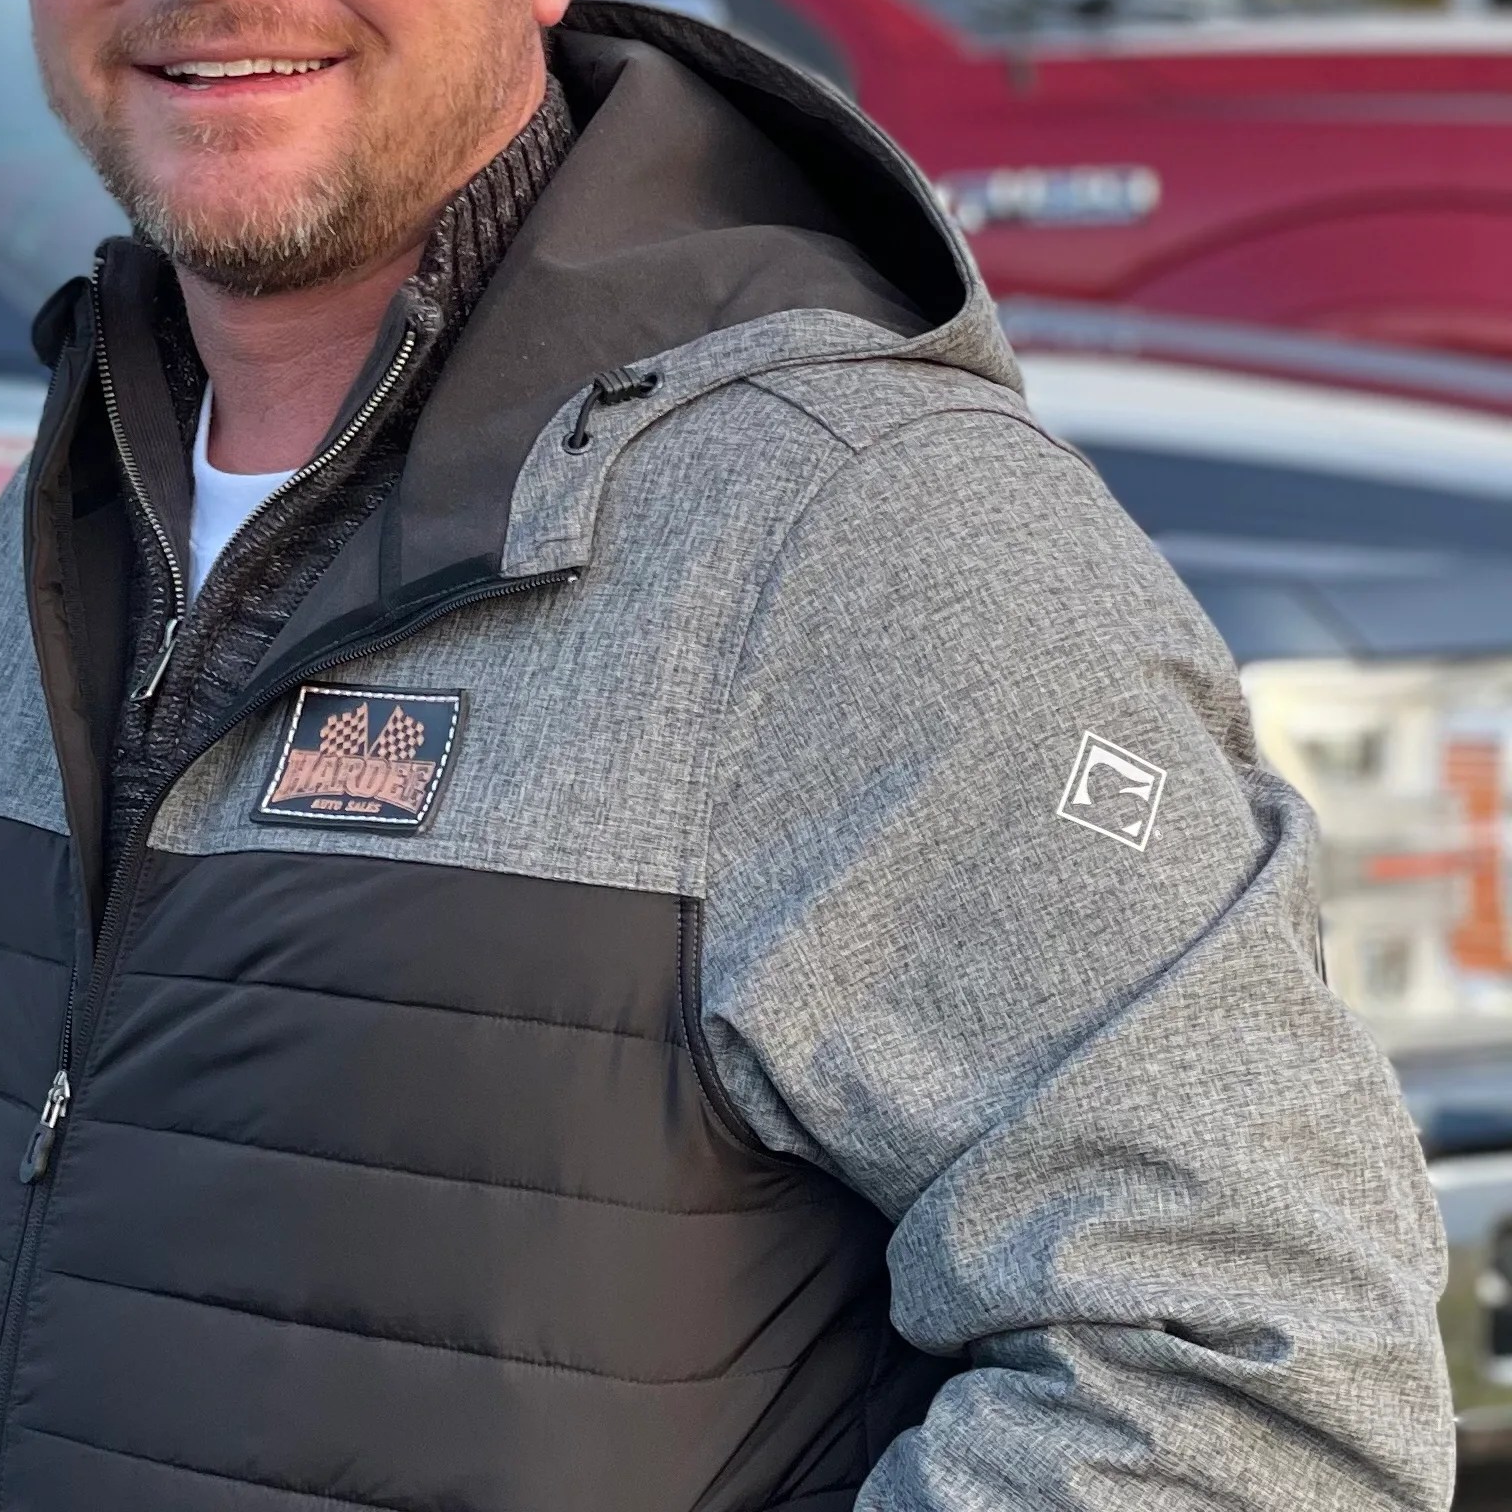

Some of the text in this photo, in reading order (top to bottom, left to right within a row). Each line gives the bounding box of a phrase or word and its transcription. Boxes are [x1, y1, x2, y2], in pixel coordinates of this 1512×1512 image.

[271, 748, 436, 815] HARDEE
[310, 798, 383, 814] AUTO SALES
